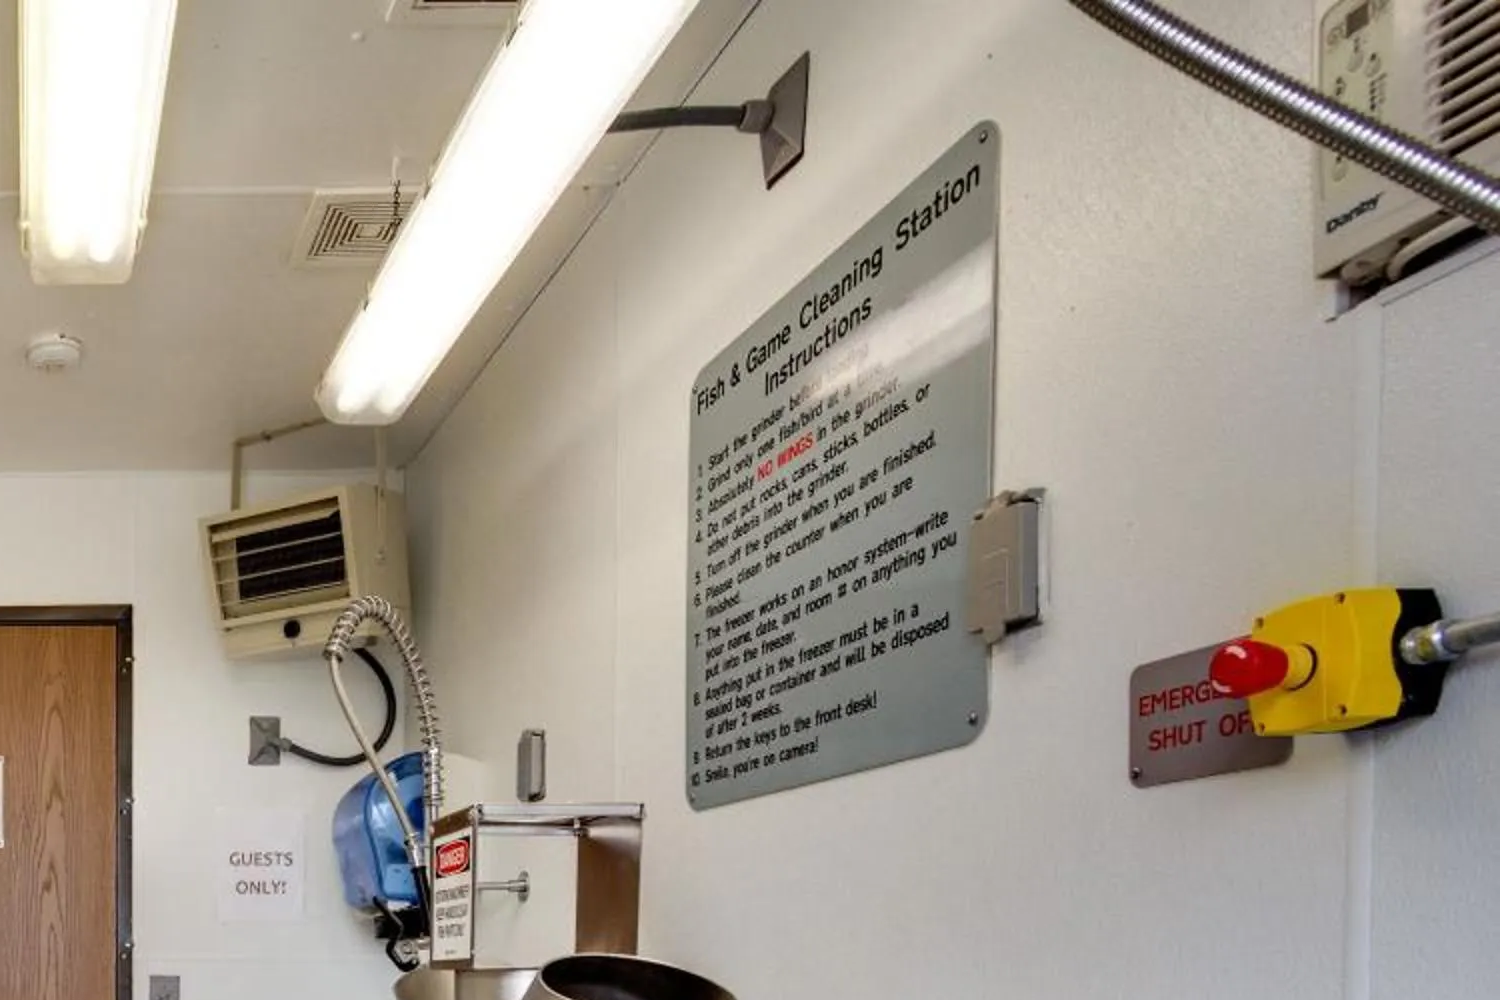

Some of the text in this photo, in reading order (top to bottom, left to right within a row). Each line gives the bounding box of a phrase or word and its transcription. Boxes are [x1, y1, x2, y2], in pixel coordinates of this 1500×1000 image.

[697, 164, 980, 416] Fish & Game Cleaning Station
[765, 297, 872, 397] Instructions
[707, 465, 731, 493] Grind
[733, 454, 753, 475] only
[757, 437, 775, 458] one
[778, 400, 823, 443] fish/bird
[827, 391, 840, 409] at
[843, 383, 851, 399] a
[707, 522, 719, 538] Do
[722, 508, 737, 528] not
[740, 496, 757, 518] put
[915, 383, 931, 403] or
[707, 475, 755, 515] Absolutely
[757, 459, 773, 481] NO
[777, 431, 813, 468] WINGS
[816, 426, 827, 442] in
[831, 410, 851, 432] the
[708, 444, 729, 471] Start
[733, 434, 748, 453] the
[751, 406, 785, 442] grinder
[705, 577, 733, 602] Please
[736, 561, 761, 585] clean
[765, 551, 781, 569] the
[785, 526, 825, 557] counter
[829, 507, 859, 532] when
[865, 491, 887, 517] you
[891, 476, 913, 499] are
[707, 460, 848, 557] other debris into the grinder.
[707, 559, 726, 578] Turn
[728, 546, 741, 566] off
[745, 539, 760, 557] the
[763, 516, 798, 549] grinder
[801, 498, 829, 523] when
[833, 483, 855, 509] you
[859, 468, 879, 490] are
[705, 625, 721, 641] The
[724, 609, 755, 633] freezer
[759, 593, 788, 617] works
[791, 584, 805, 601] on
[808, 575, 823, 592] an
[827, 556, 859, 583] honor
[863, 511, 949, 565] system-write
[705, 643, 725, 664] your
[781, 603, 801, 626] and
[805, 592, 833, 615] room
[837, 582, 847, 599] #
[851, 575, 867, 593] on
[871, 547, 926, 584] anything
[931, 531, 957, 559] you
[705, 677, 743, 701] Anything
[745, 666, 762, 689] put
[765, 663, 775, 678] in
[778, 655, 795, 673] the
[798, 639, 835, 665] freezer
[839, 621, 869, 647] must
[873, 617, 889, 635] be
[893, 608, 905, 625] in
[911, 604, 919, 618] a
[705, 631, 797, 682] put into the freezer.
[705, 611, 950, 721] sealed bag or container and will be disposed
[705, 703, 782, 739] of after 2 weeks.
[705, 743, 733, 761] Return
[735, 736, 751, 751] the
[754, 728, 777, 746] keys
[779, 723, 791, 738] to
[793, 717, 811, 733] the
[815, 703, 843, 727] front
[845, 690, 877, 717] desk!
[763, 753, 776, 767] on
[778, 735, 819, 763] camera!
[1148, 719, 1206, 751] SHUT
[229, 851, 294, 867] GUESTS
[235, 879, 288, 896] ONLY!
